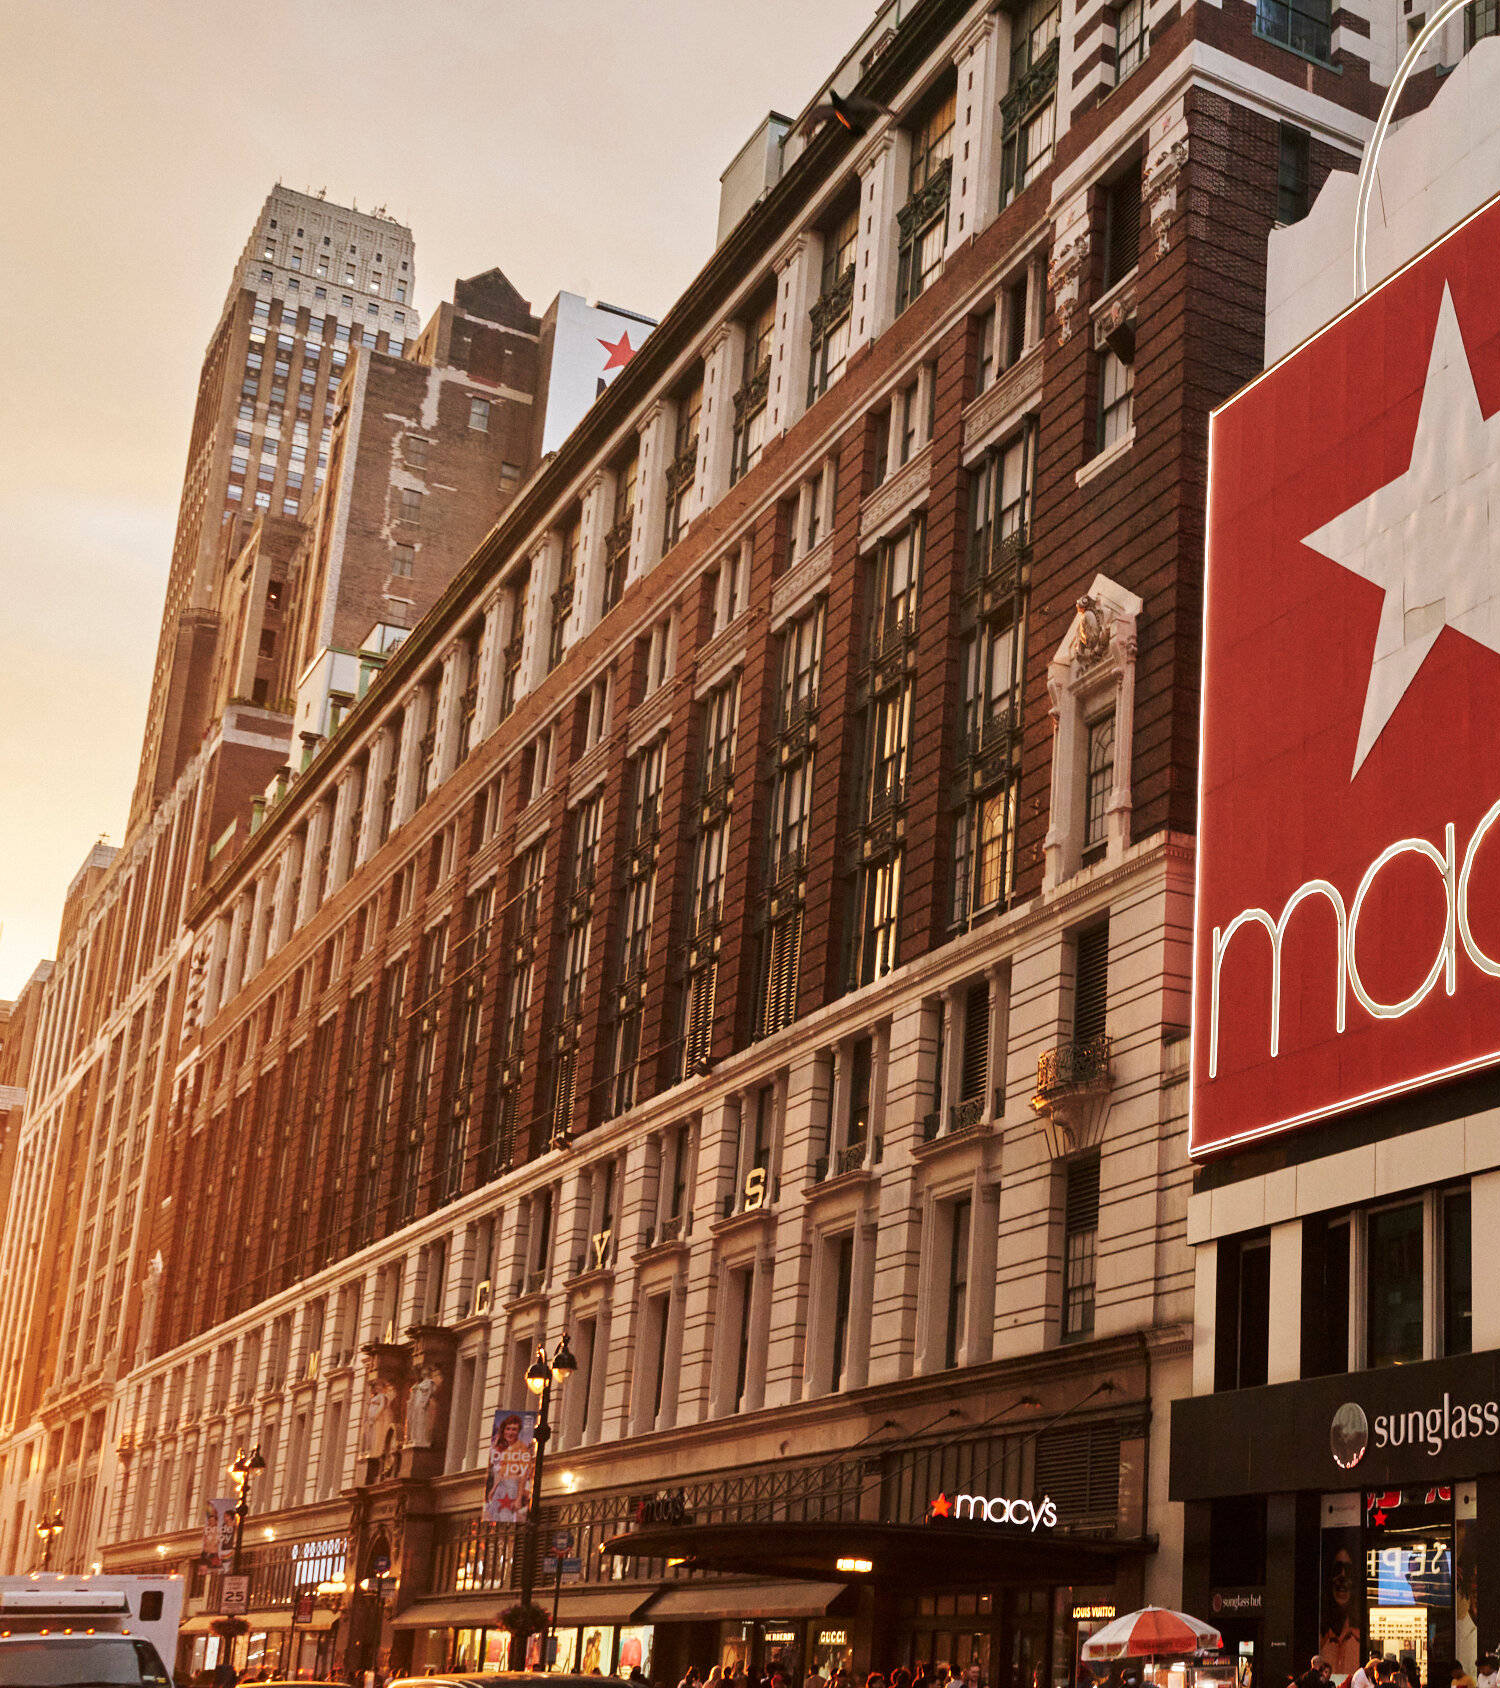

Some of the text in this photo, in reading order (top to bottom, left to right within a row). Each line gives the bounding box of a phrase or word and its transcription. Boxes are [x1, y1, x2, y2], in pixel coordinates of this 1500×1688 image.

[1374, 1392, 1500, 1456] sunglass
[490, 1448, 532, 1463] pride
[504, 1462, 529, 1477] joy
[955, 1494, 1058, 1532] macy's
[224, 1591, 245, 1602] 25
[1072, 1606, 1091, 1619] LOUIS
[820, 1630, 846, 1643] GUCCI
